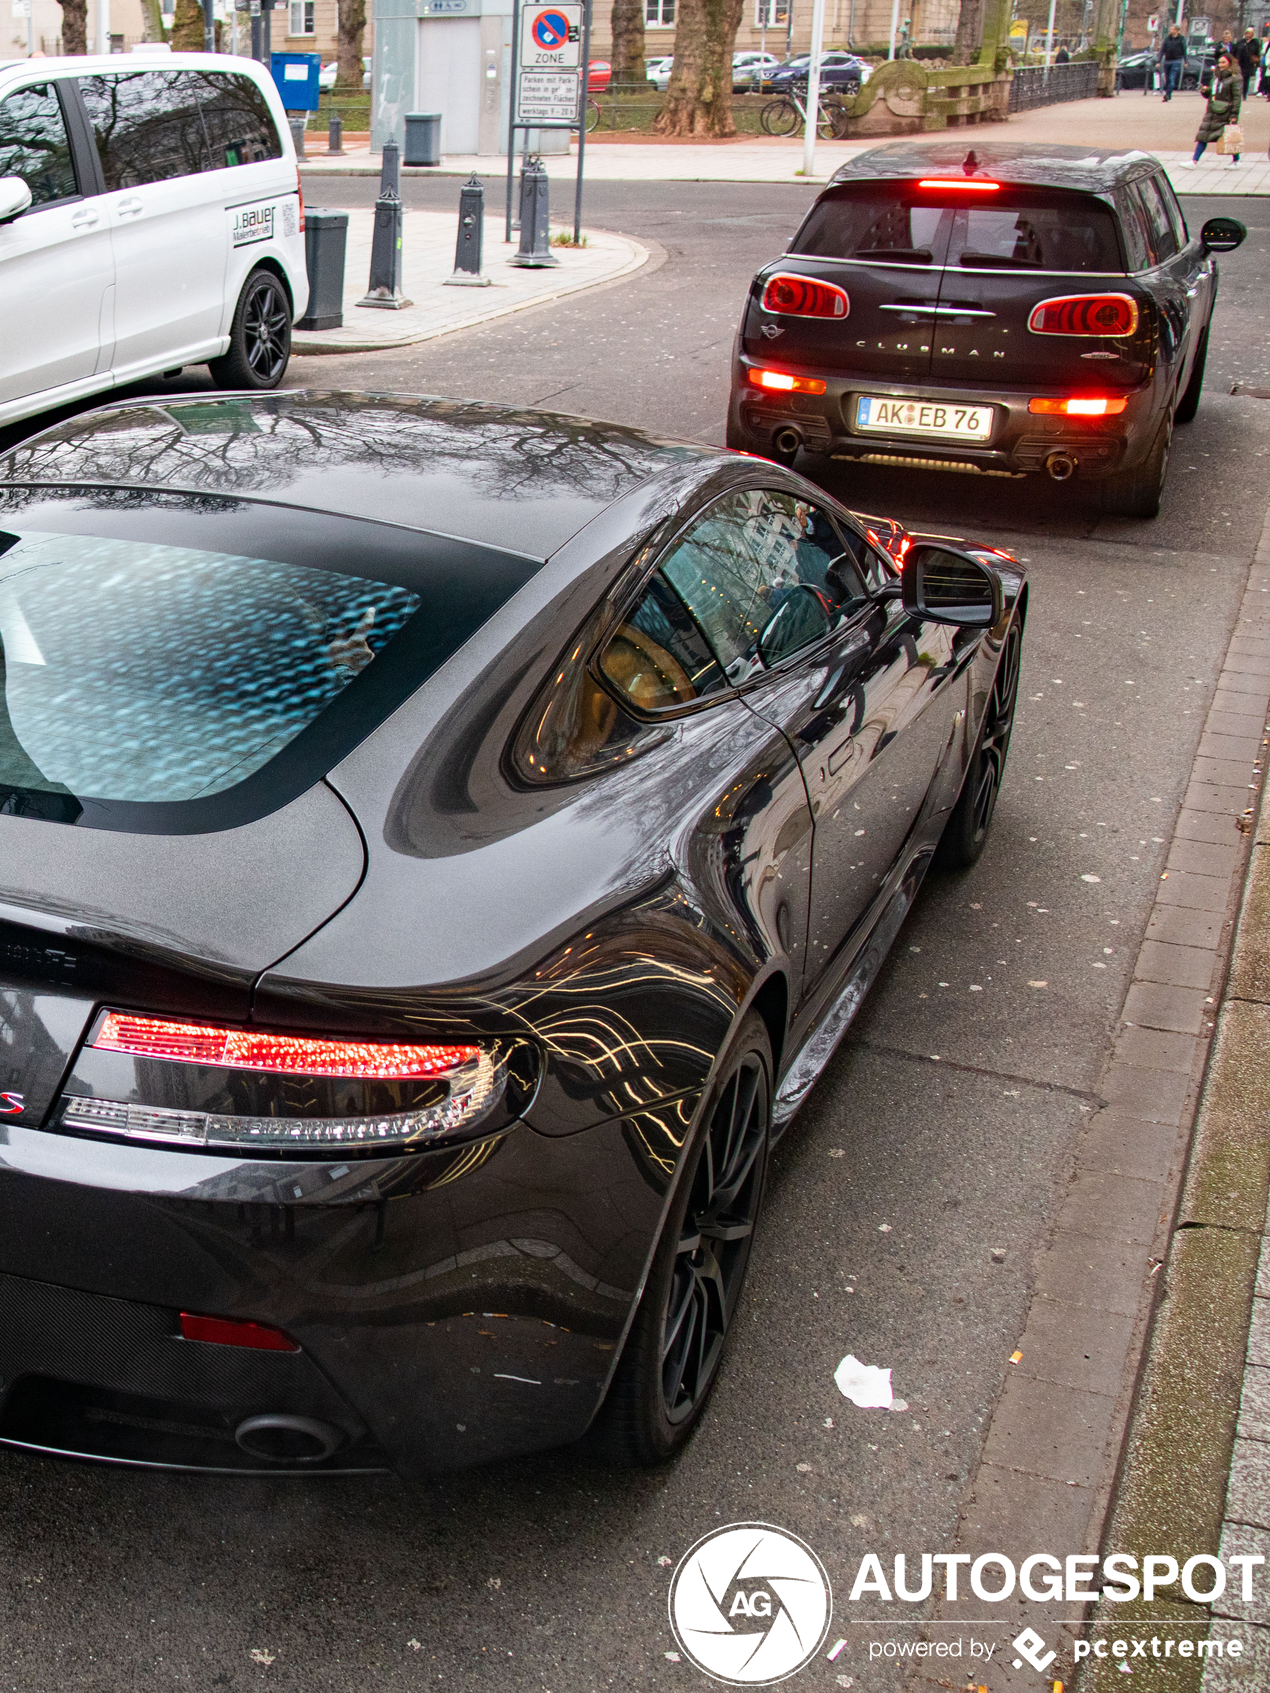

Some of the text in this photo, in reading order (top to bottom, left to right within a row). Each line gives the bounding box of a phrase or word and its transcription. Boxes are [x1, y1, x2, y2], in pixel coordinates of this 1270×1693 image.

[535, 54, 564, 63] ZONE
[522, 108, 548, 116] werktags
[233, 225, 270, 241] Malerbetrieb
[856, 340, 1005, 358] CLUBMAN
[877, 403, 980, 430] AK EB 76
